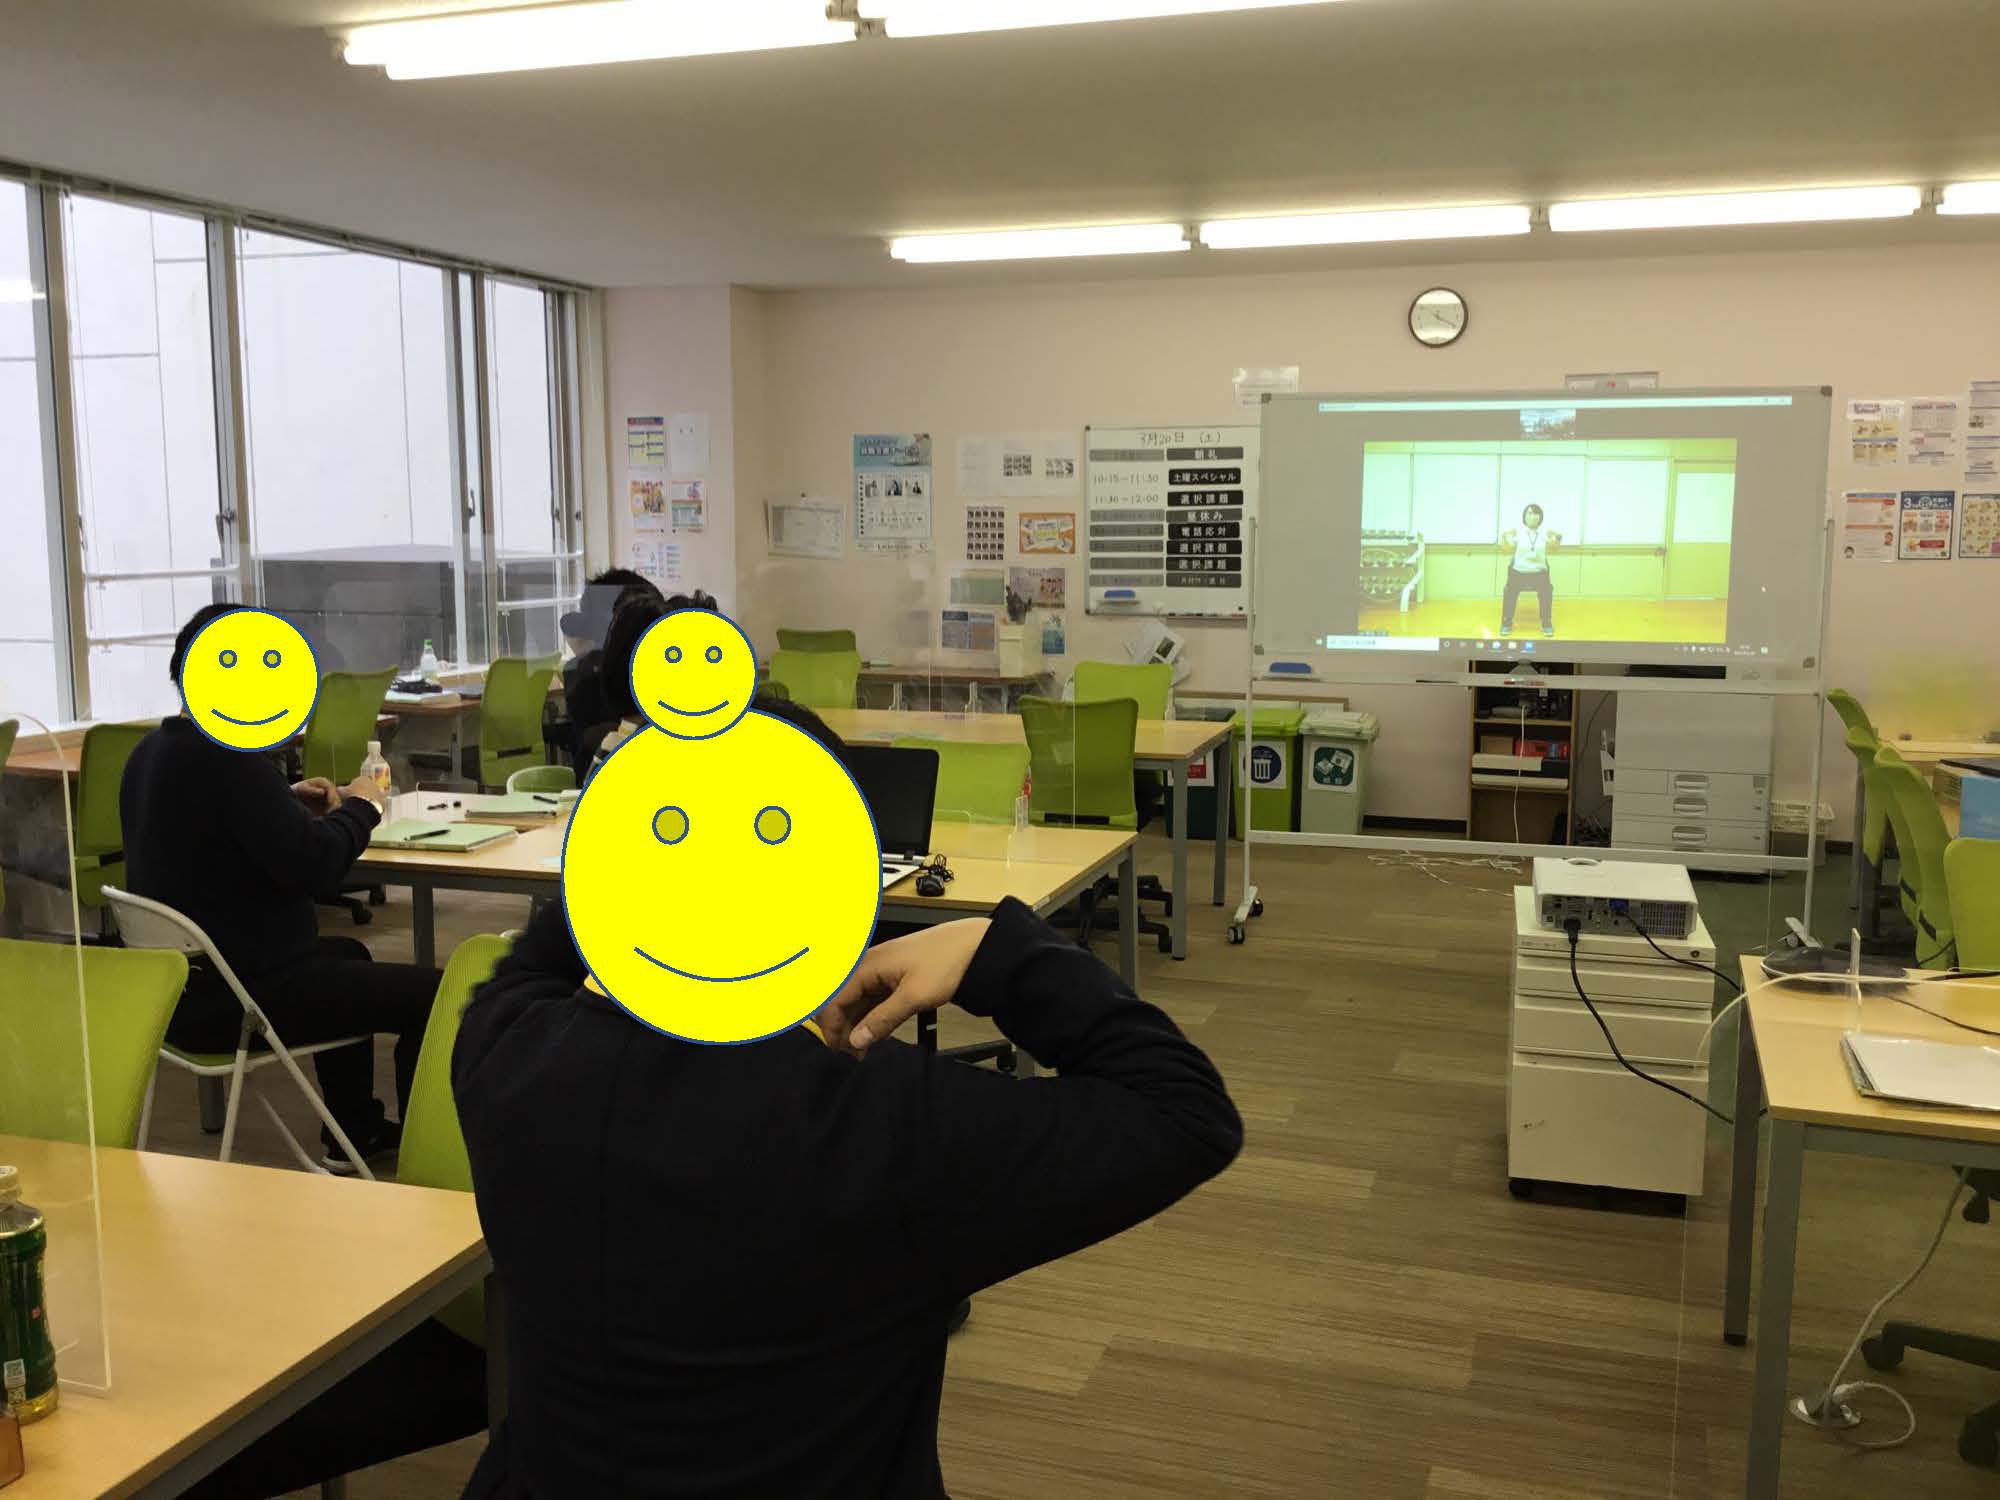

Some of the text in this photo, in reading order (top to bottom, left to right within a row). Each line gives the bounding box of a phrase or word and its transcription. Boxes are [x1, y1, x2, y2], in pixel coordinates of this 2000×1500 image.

[1173, 472, 1236, 482] 土曜スペシャル
